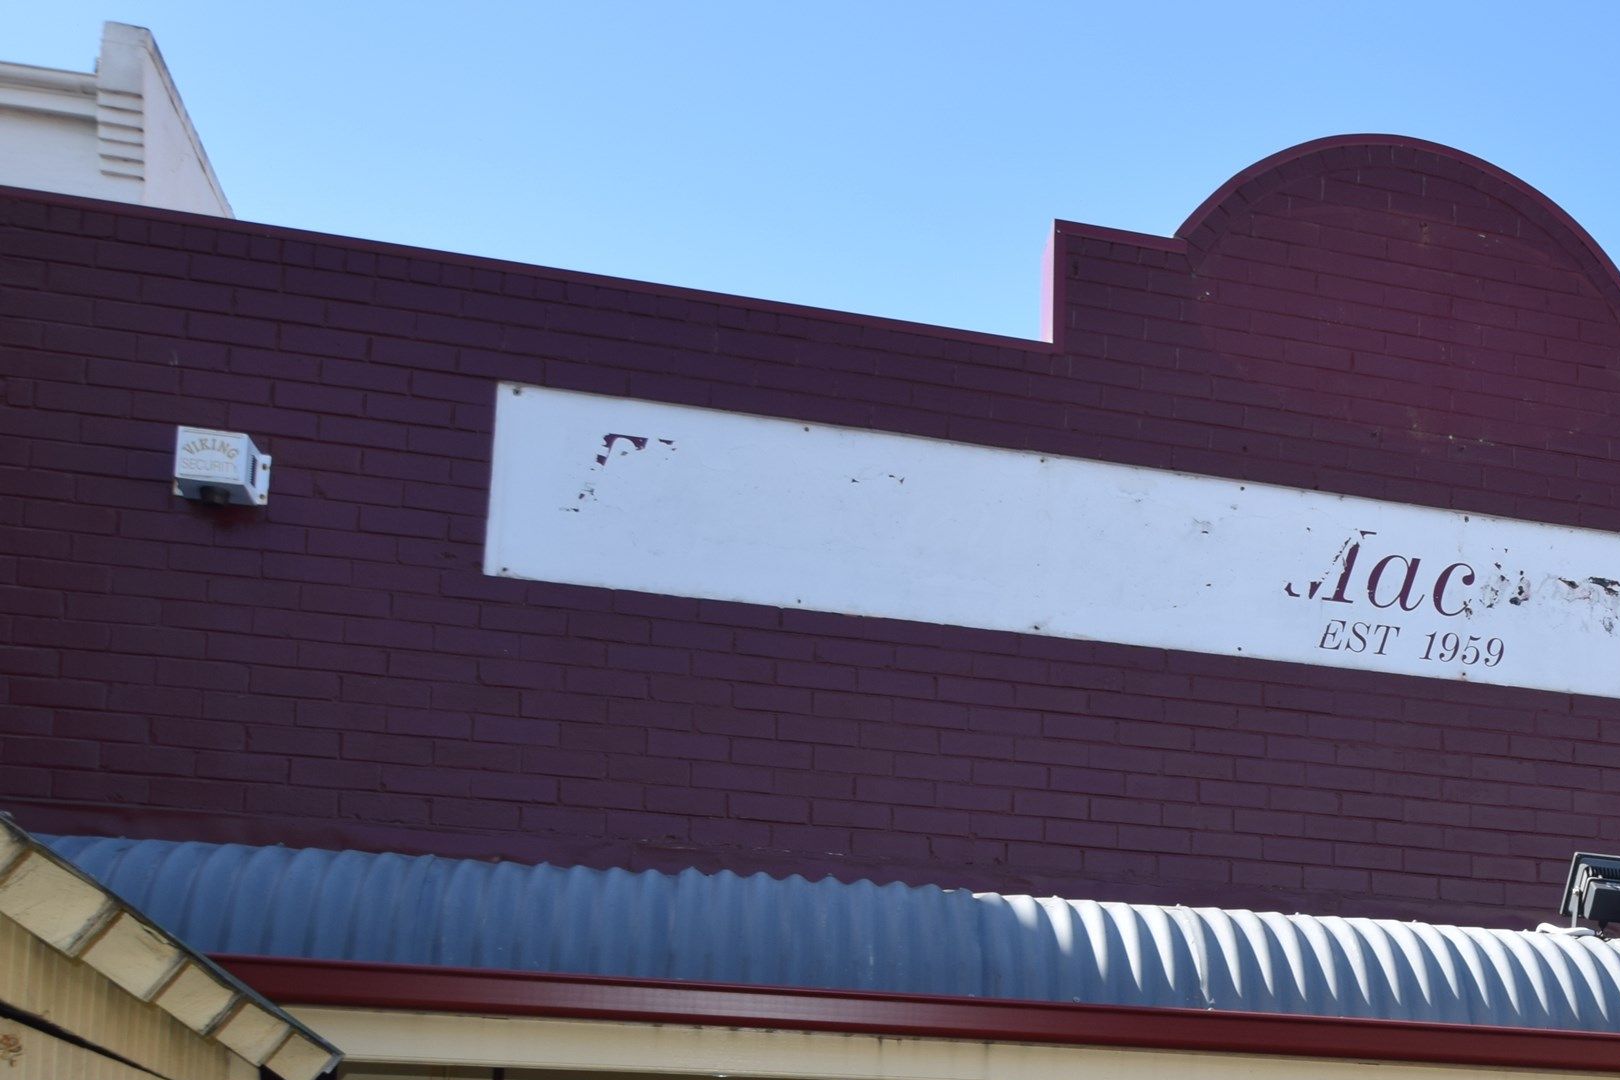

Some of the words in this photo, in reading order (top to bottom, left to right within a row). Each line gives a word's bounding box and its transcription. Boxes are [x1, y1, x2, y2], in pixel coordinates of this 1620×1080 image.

[182, 437, 239, 460] VIKING
[1317, 619, 1401, 656] EST
[1418, 631, 1505, 667] 1959
